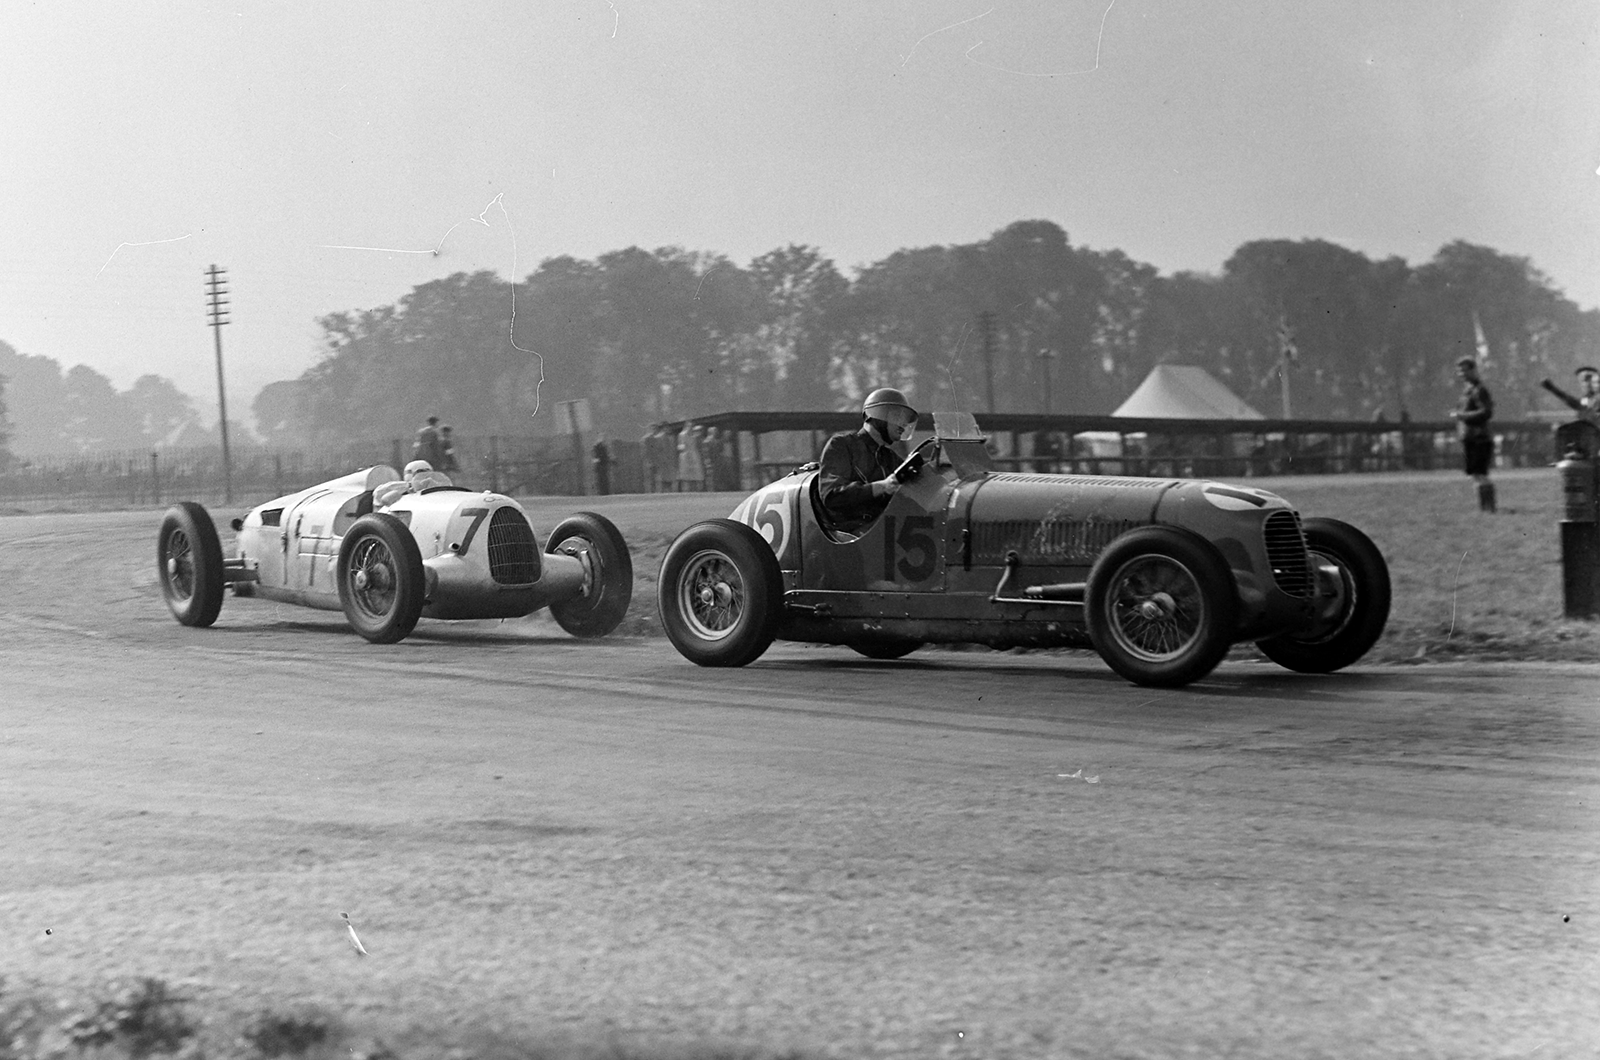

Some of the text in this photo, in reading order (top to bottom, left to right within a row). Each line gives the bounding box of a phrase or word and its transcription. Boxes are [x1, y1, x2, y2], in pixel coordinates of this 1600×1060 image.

[458, 507, 490, 556] 7
[746, 492, 784, 555] 15
[884, 515, 937, 582] 15
